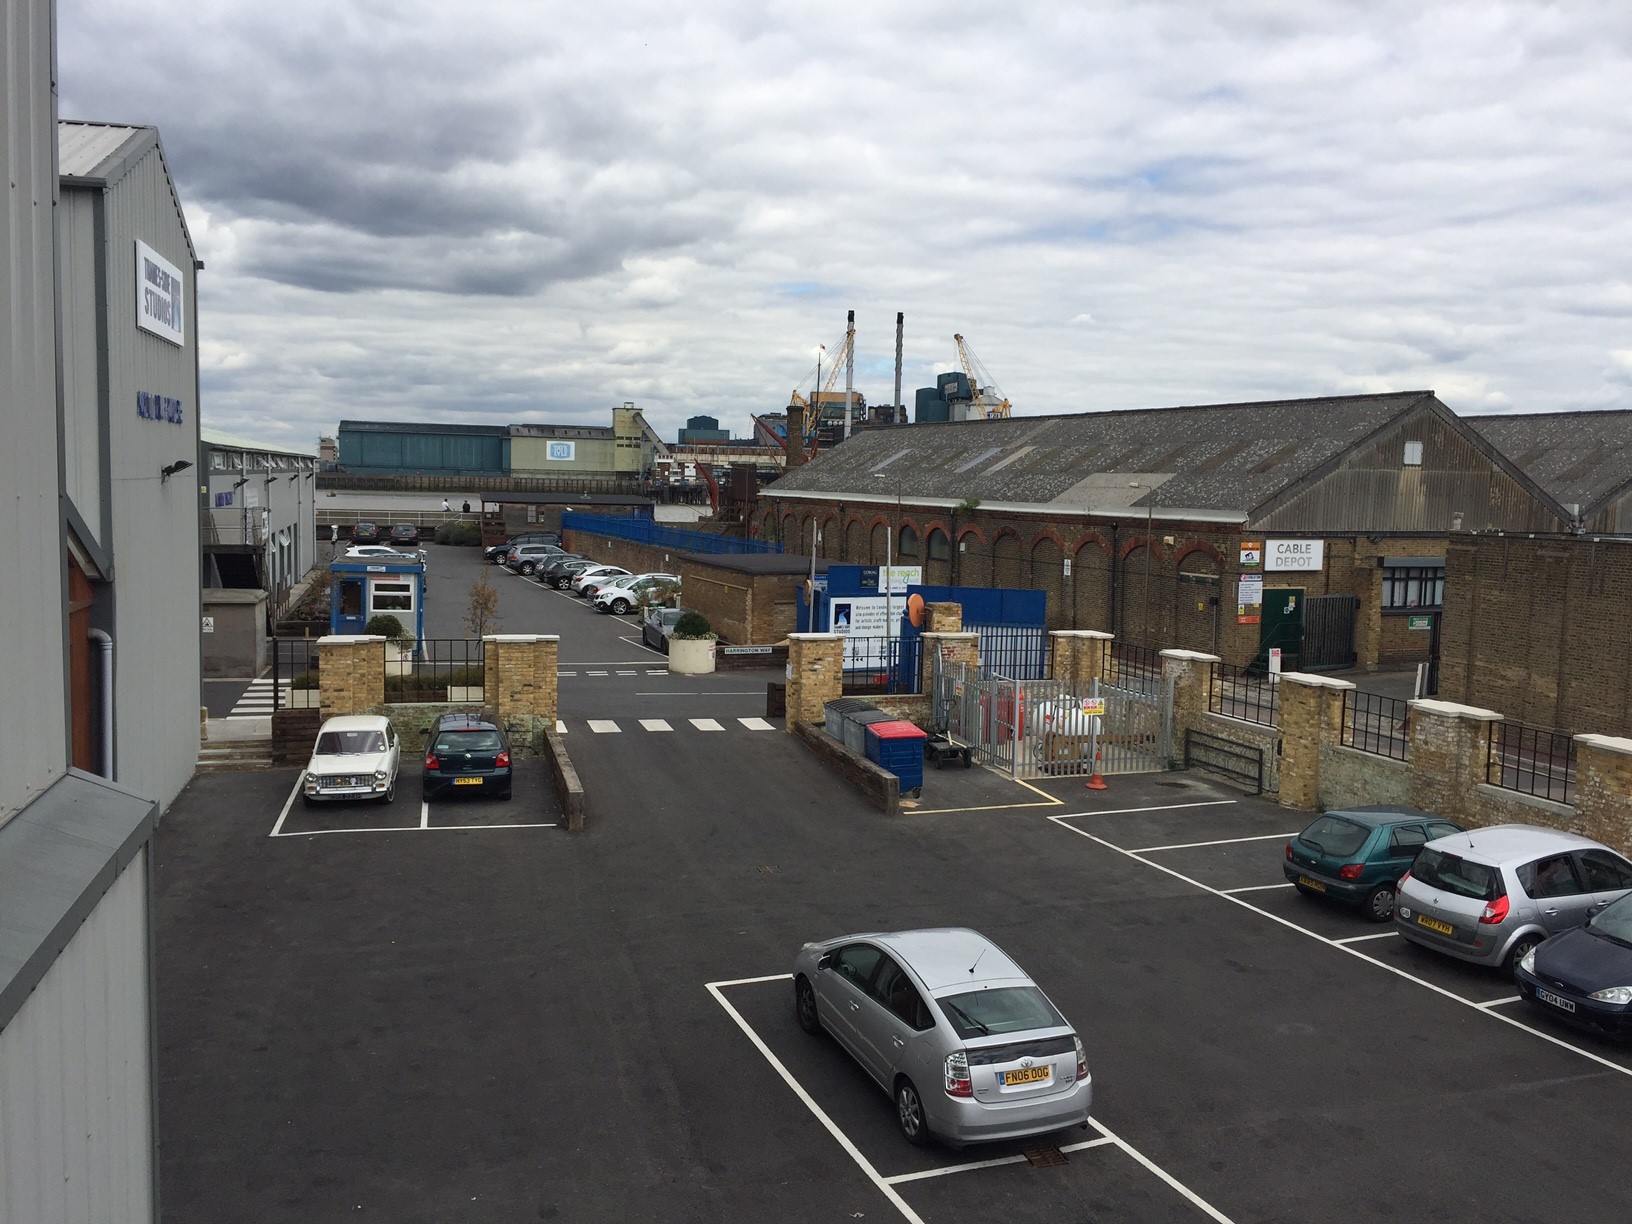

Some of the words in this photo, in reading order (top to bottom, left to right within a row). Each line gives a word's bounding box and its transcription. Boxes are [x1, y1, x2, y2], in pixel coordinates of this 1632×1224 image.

[144, 287, 171, 327] STUDIOS
[1277, 544, 1312, 554] CABLE
[1275, 557, 1312, 567] DEPOT
[897, 568, 920, 577] reach
[1005, 1070, 1030, 1083] FN06
